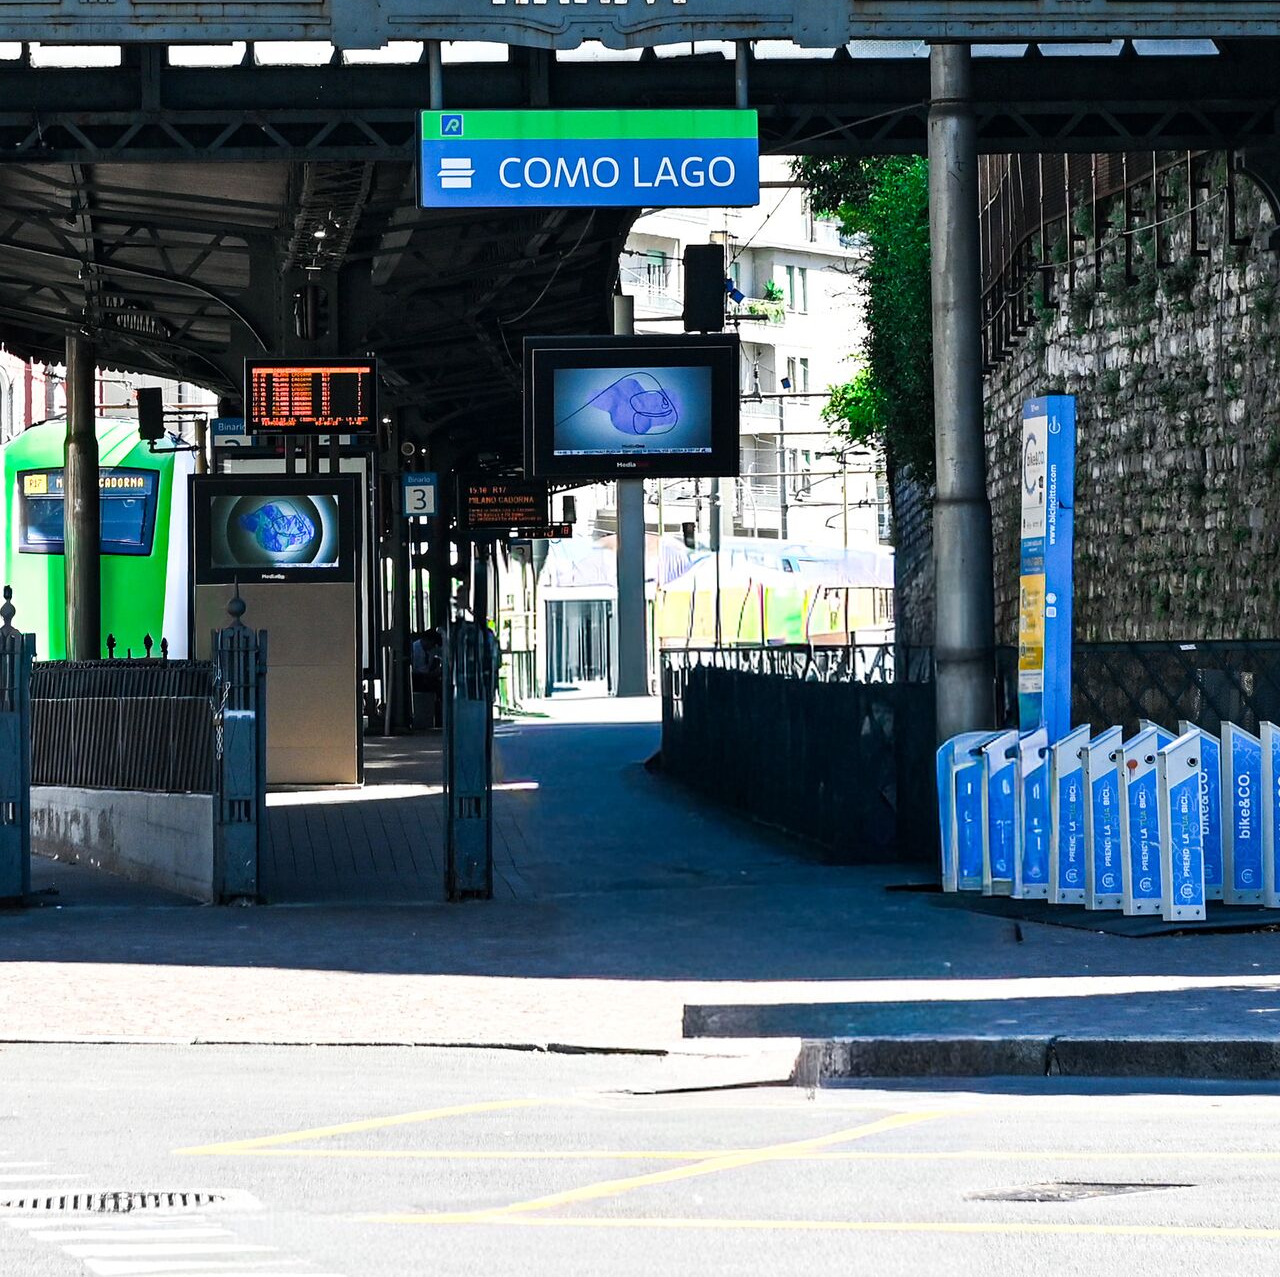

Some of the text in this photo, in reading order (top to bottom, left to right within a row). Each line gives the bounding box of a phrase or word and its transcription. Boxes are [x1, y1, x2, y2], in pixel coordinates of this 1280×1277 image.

[498, 156, 736, 189] COMO LAGO
[99, 478, 143, 488] CADORNA
[413, 489, 426, 510] 3
[1238, 771, 1251, 839] bike&CO.
[1069, 821, 1076, 831] LA
[1104, 825, 1111, 835] LA
[1140, 828, 1147, 839] LA
[1182, 833, 1189, 844] LA
